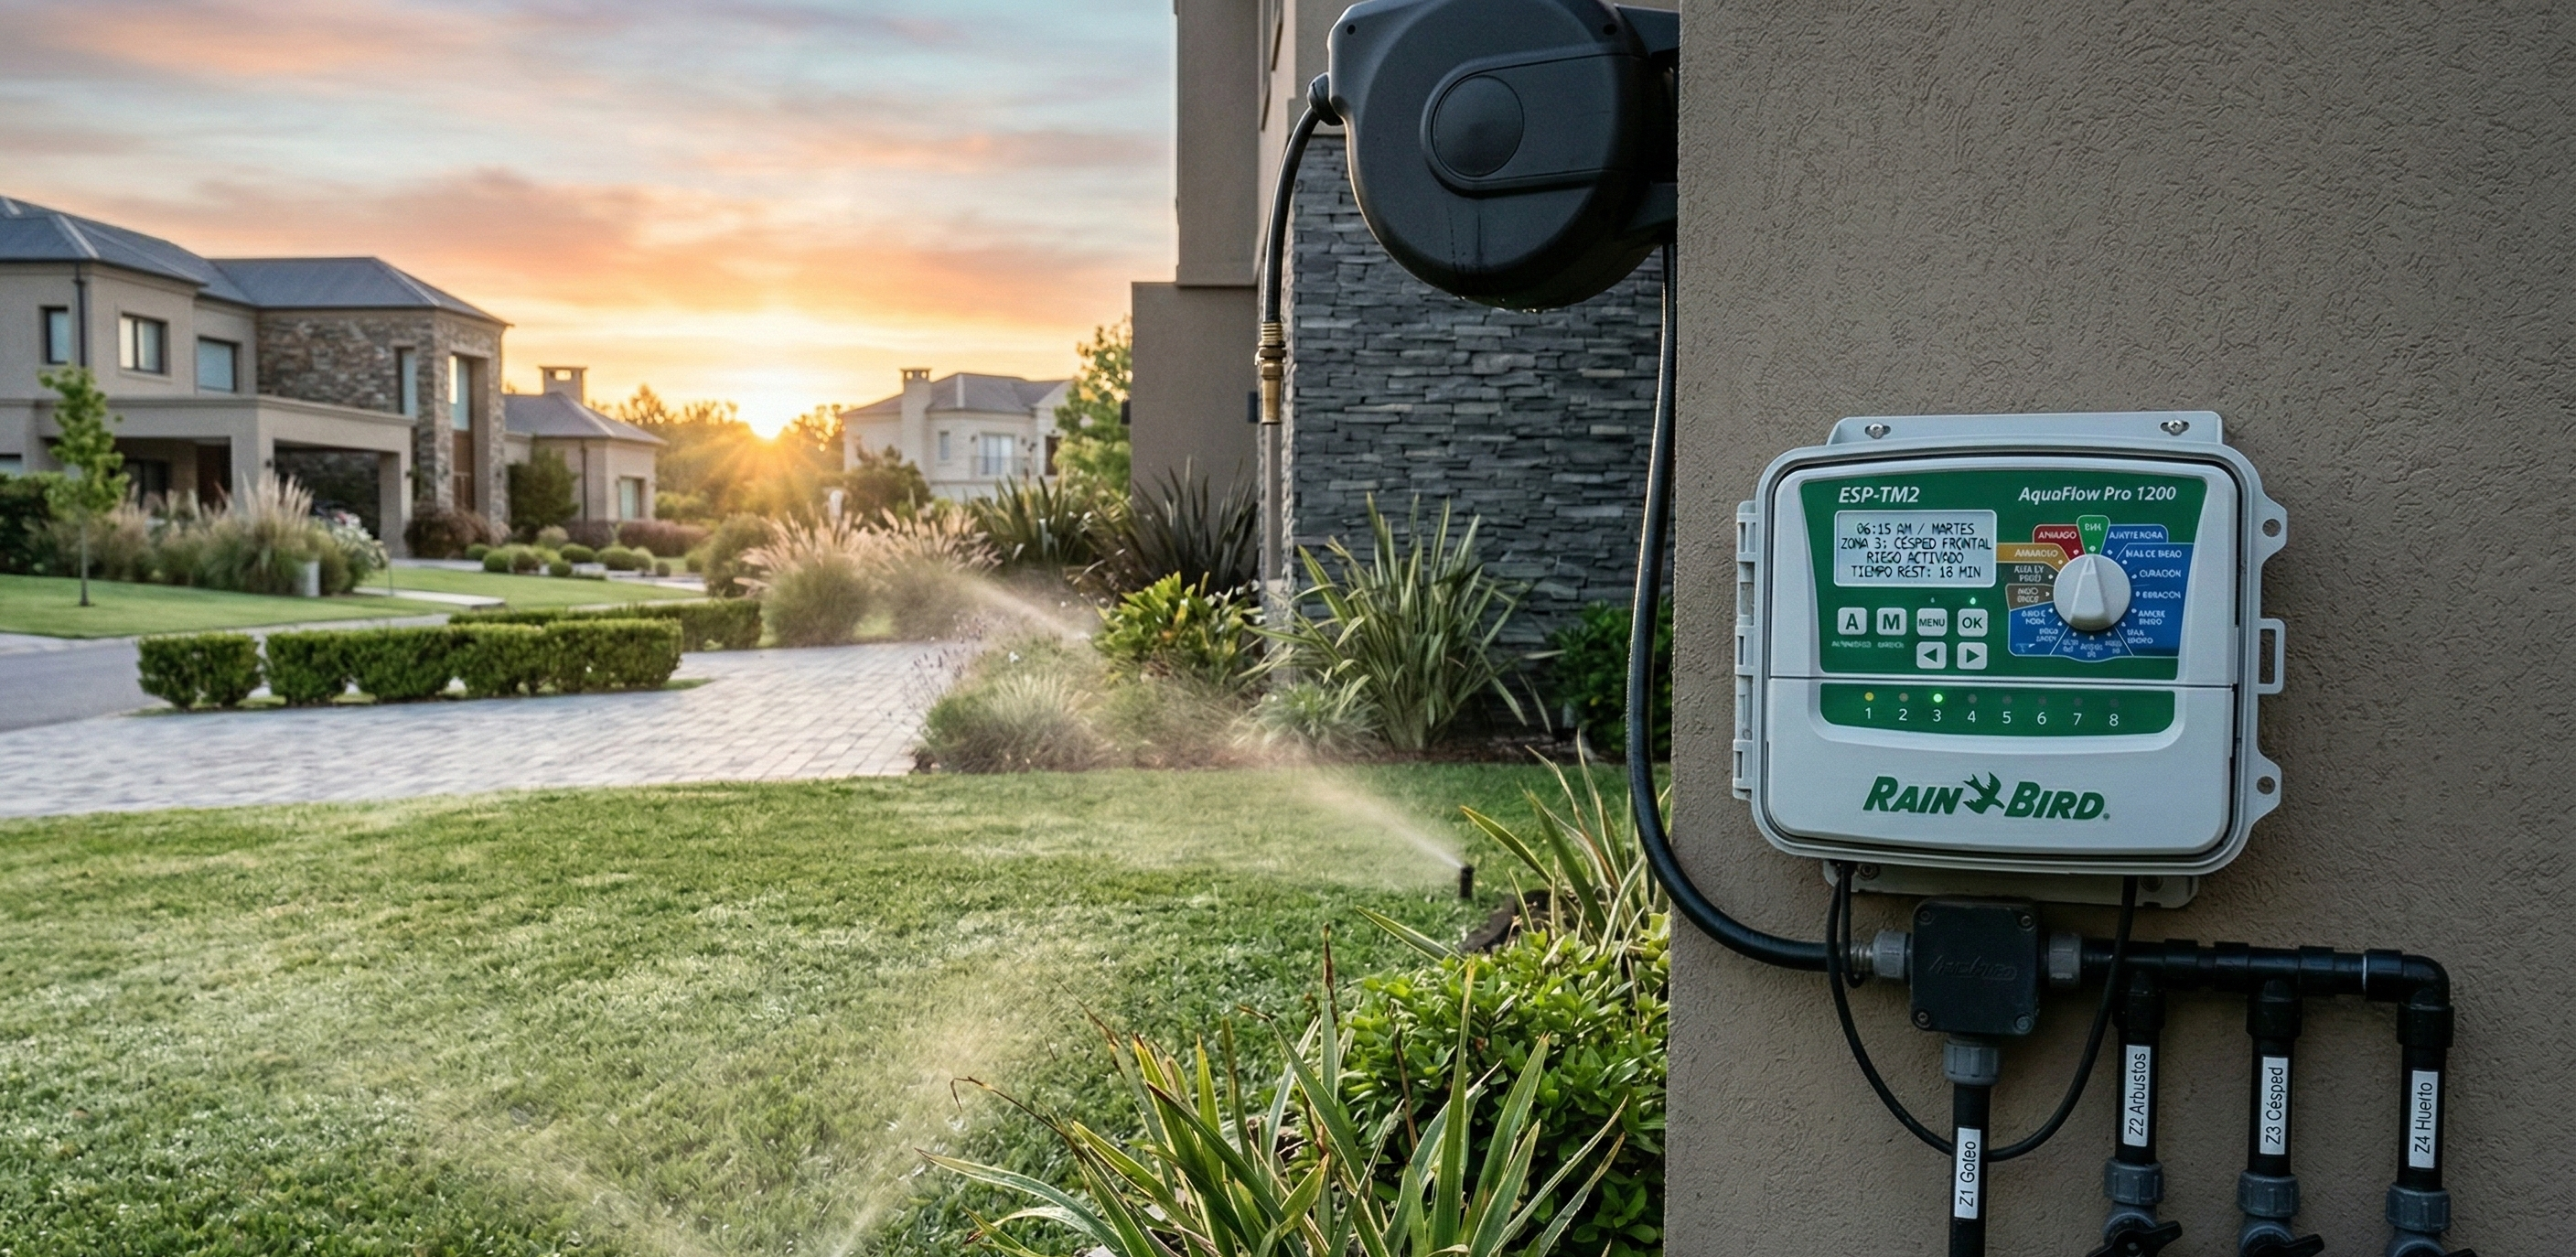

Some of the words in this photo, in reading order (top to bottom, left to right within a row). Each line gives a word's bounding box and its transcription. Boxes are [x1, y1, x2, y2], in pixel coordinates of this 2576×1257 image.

[1838, 486, 1920, 503] ESP-TM2
[2018, 486, 2101, 506] AquaFlow
[2103, 486, 2131, 501] Pro
[2137, 486, 2177, 501] 1200
[1856, 522, 1892, 535] 06:15
[1896, 522, 1913, 535] AM
[1931, 522, 1975, 535] MARTES
[1845, 613, 1859, 630] A
[1883, 614, 1900, 630] M
[1918, 618, 1946, 627] MENU
[1962, 617, 1983, 629] OK
[1864, 707, 1872, 719] 1
[1898, 708, 1908, 721] 2
[1932, 709, 1942, 722] 3
[1967, 710, 1977, 723] 4
[2002, 711, 2012, 724] 5
[2036, 712, 2047, 725] 6
[2073, 713, 2082, 725] 7
[2109, 714, 2119, 726] 8
[1862, 776, 1964, 814] RAIN
[2129, 1053, 2146, 1115] Arbustos
[2266, 1067, 2285, 1121] Césped
[2129, 1117, 2144, 1137] Z2
[2265, 1125, 2281, 1144] Z3
[2414, 1135, 2431, 1154] Z4
[1959, 1189, 1974, 1207] Z1
